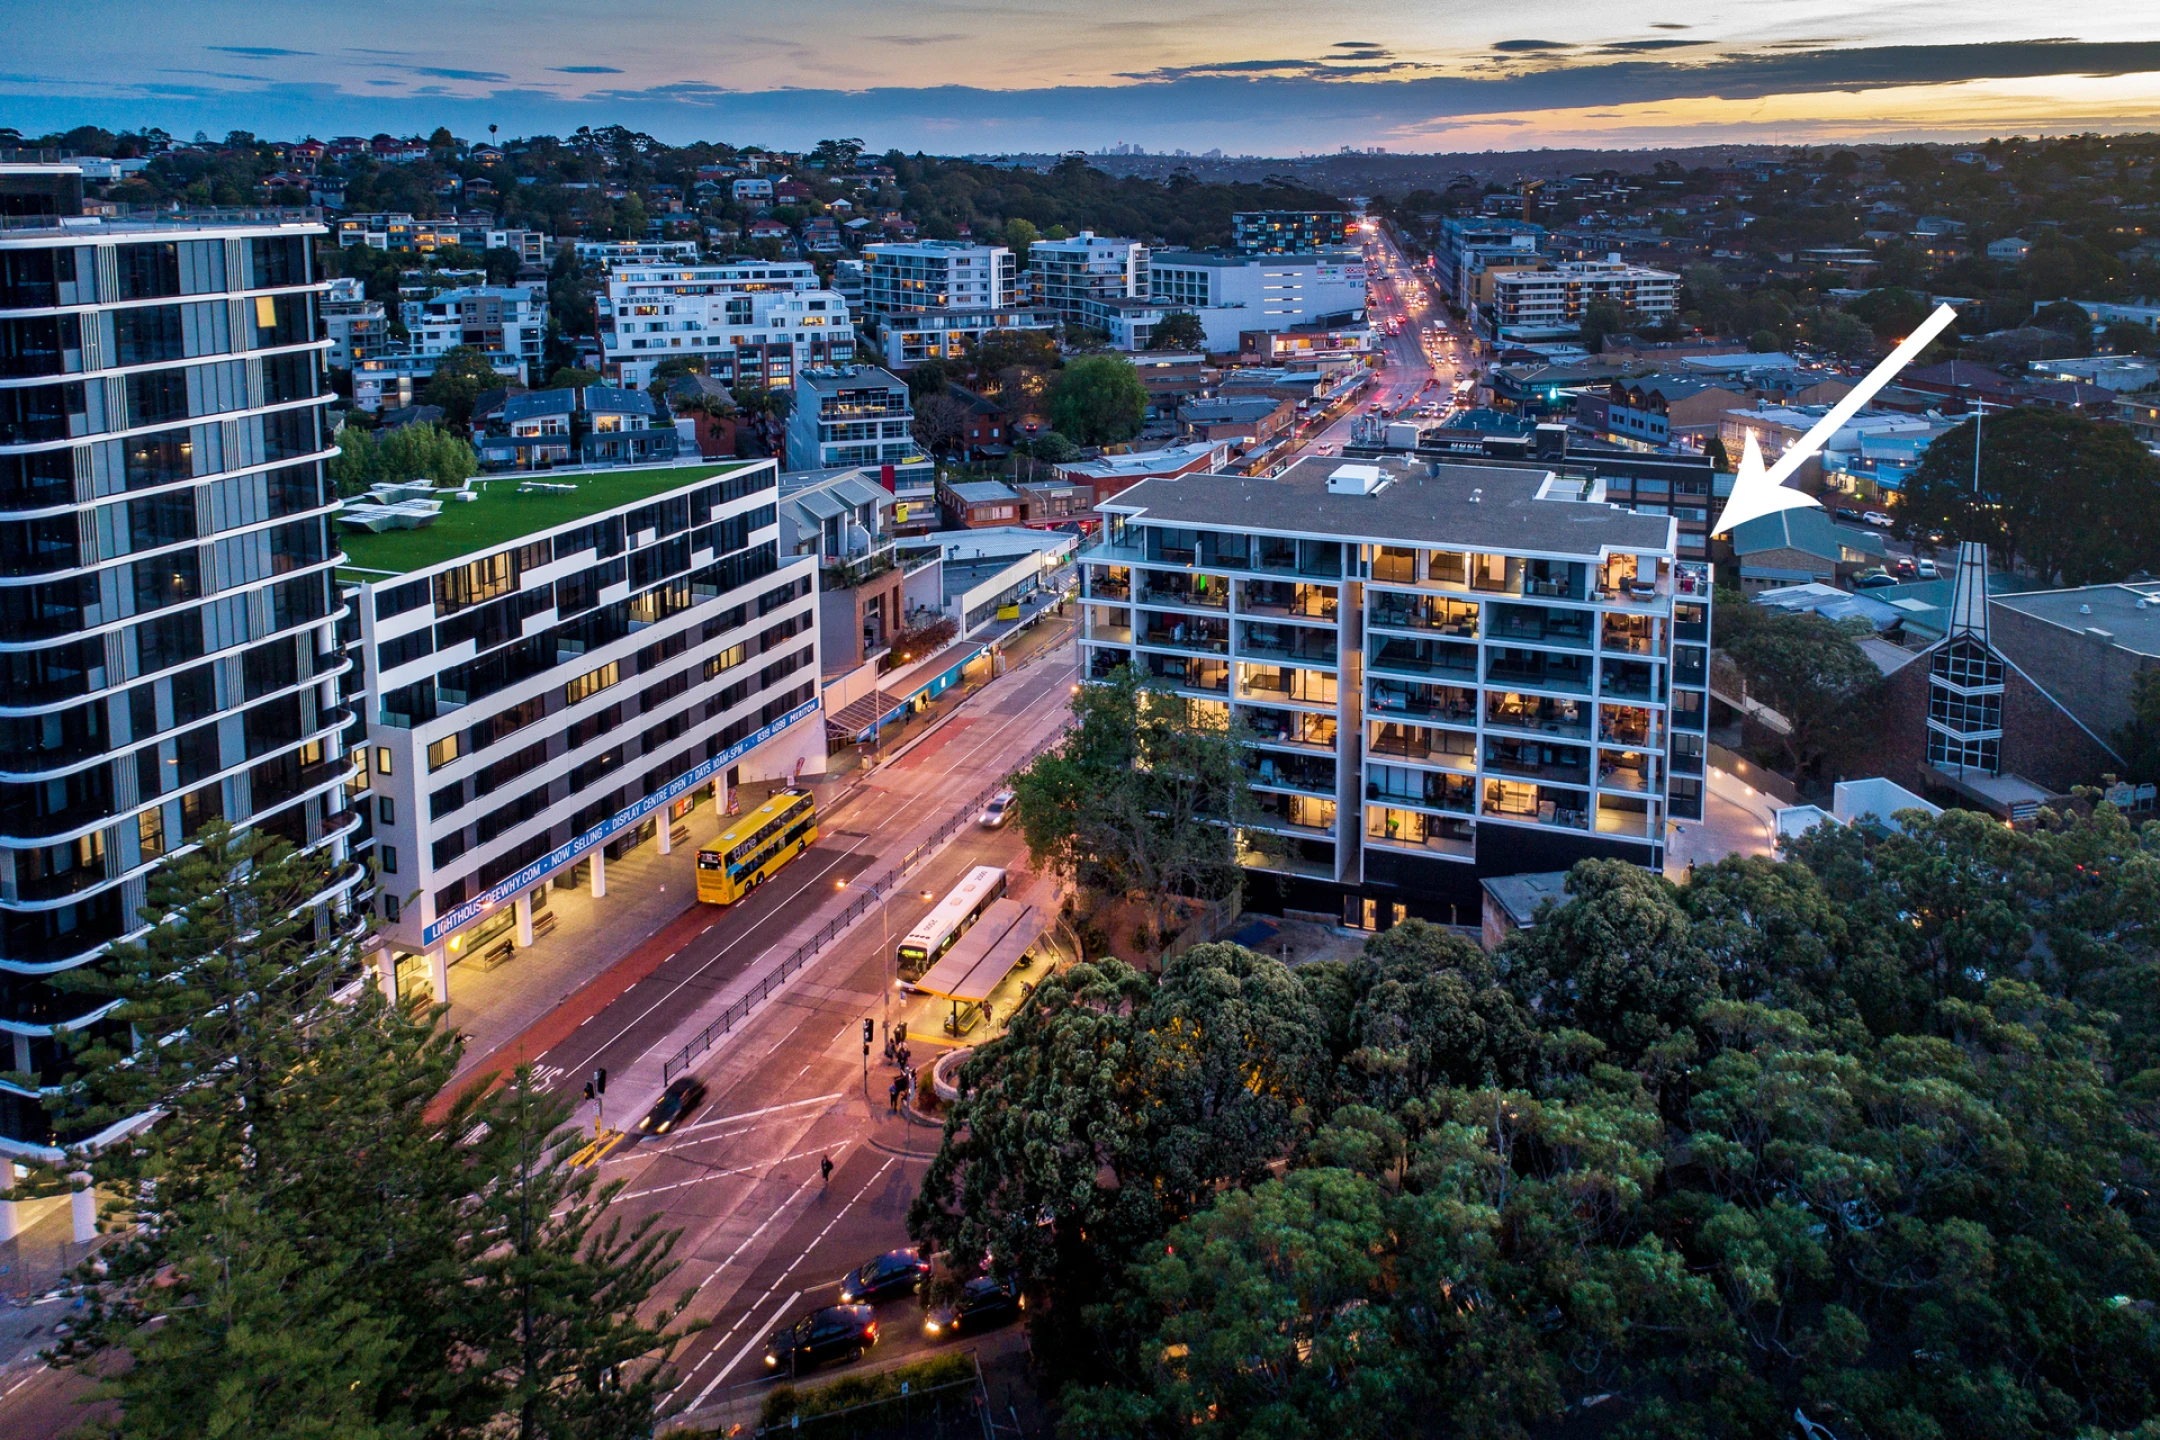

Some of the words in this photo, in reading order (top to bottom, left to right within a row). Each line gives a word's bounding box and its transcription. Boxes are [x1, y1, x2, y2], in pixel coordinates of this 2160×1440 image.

[551, 846, 570, 867] NOW
[574, 827, 602, 853] SELLING
[612, 805, 641, 830] DISPLAY
[643, 788, 667, 811] CENTRE
[670, 778, 686, 795] OPEN
[688, 773, 693, 783] 7
[695, 763, 711, 780] DAYS
[713, 743, 743, 768] 10AM-5PM
[790, 702, 816, 723] MERITON
